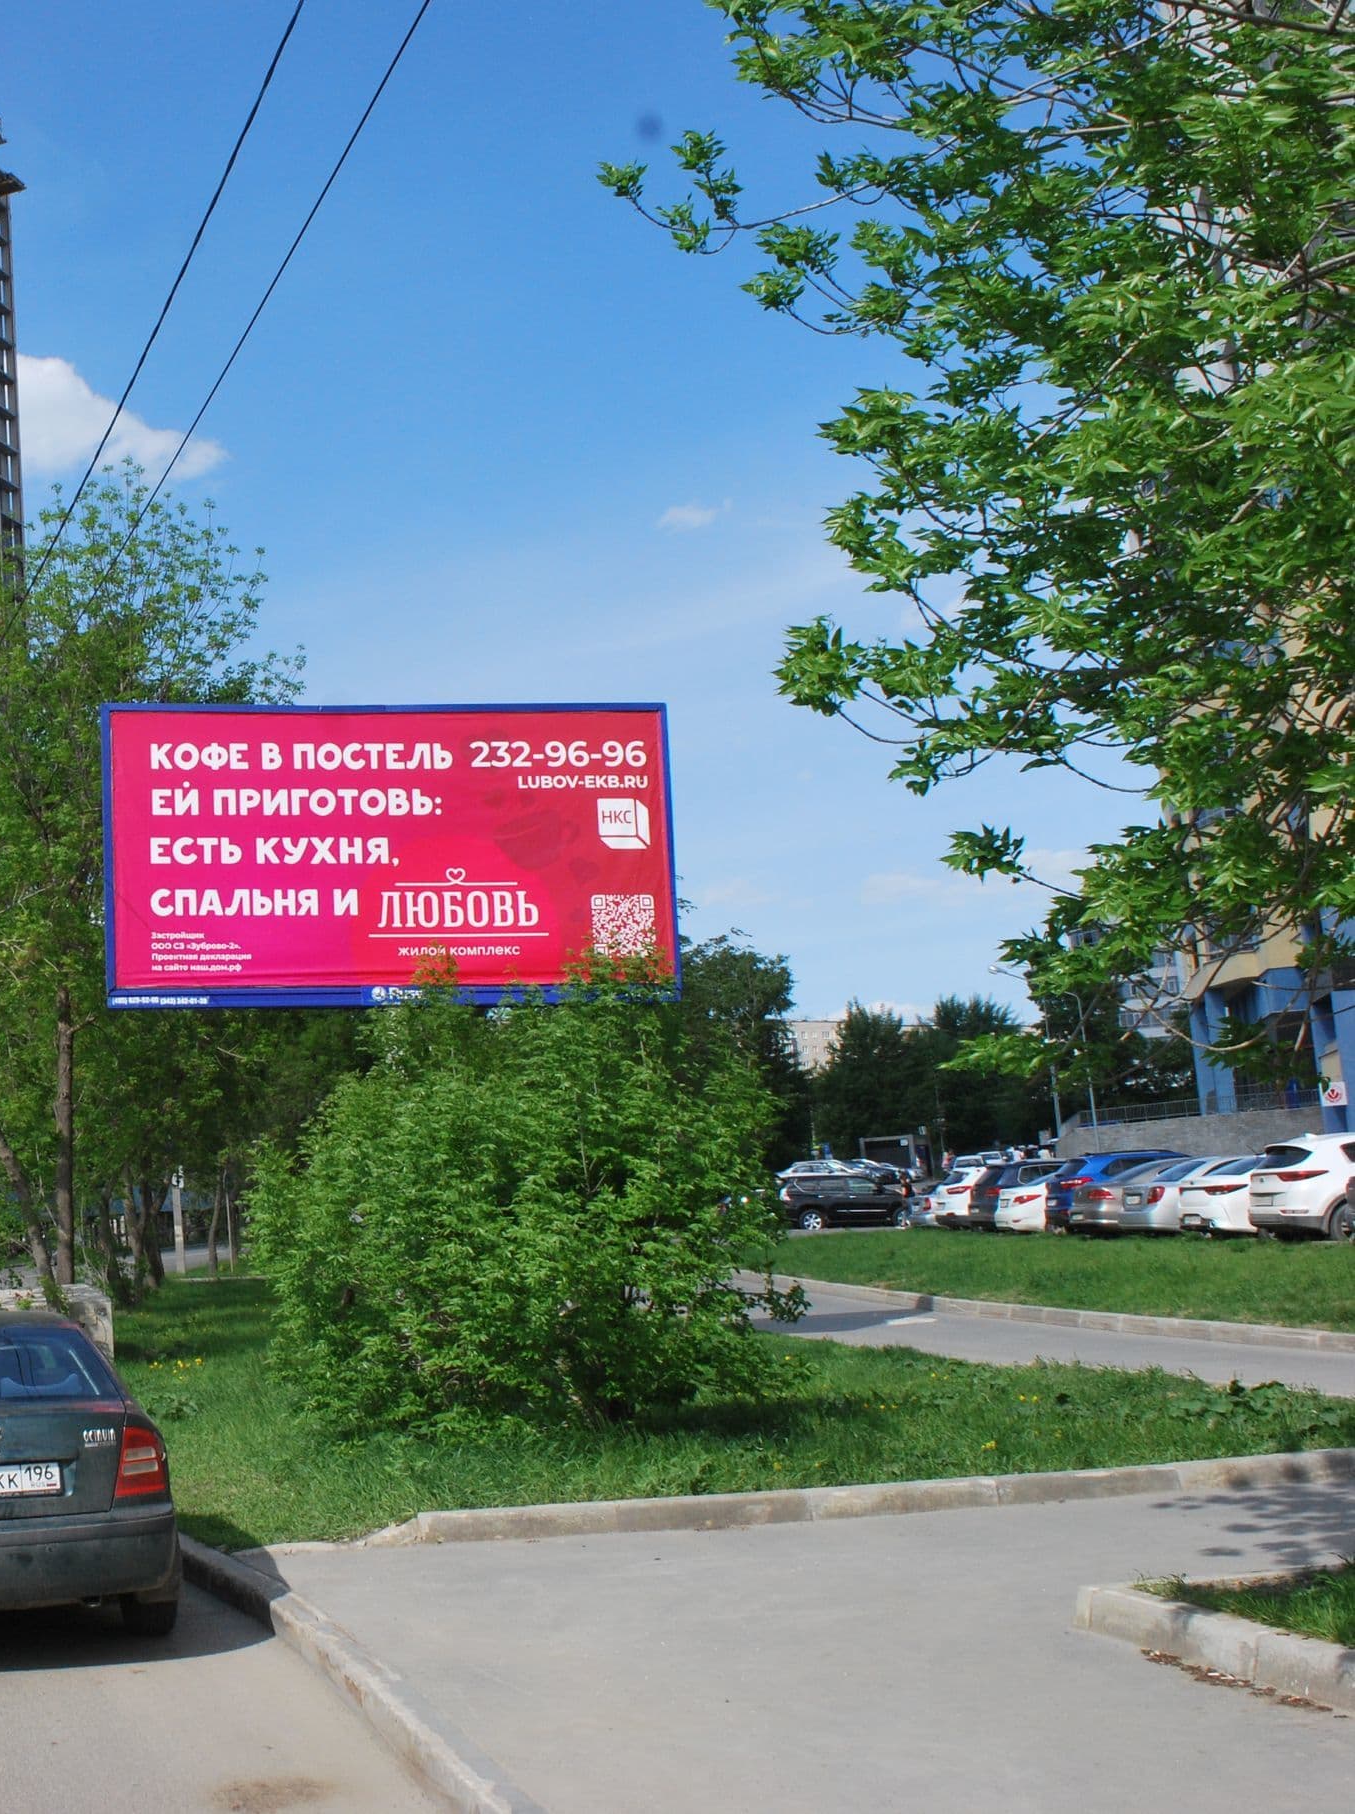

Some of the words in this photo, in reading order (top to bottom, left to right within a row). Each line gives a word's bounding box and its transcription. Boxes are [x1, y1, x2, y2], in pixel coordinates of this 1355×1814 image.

[150, 742, 249, 771] КОФЕ
[261, 742, 283, 771] В
[293, 742, 453, 771] ПОСТЕЛЬ
[470, 740, 647, 768] 232-96-96
[518, 775, 648, 789] LUBOV-EKB.RU
[151, 781, 200, 816] ЕЙ
[213, 788, 442, 816] ПРИГОТОВЬ:
[150, 837, 242, 865] ЕСТЬ
[256, 837, 399, 867] КУХНЯ,
[150, 889, 318, 917] СПАЛЬНЯ
[333, 888, 358, 917] И
[377, 890, 539, 929] ЛЮБОВЬ
[151, 942, 172, 950] ООО
[151, 952, 199, 962] Проектная
[199, 953, 252, 962] декларация
[398, 944, 446, 956] жилой
[449, 945, 521, 957] комплекс
[151, 964, 163, 972] на
[164, 963, 189, 972] сайте
[24, 1463, 54, 1481] 196
